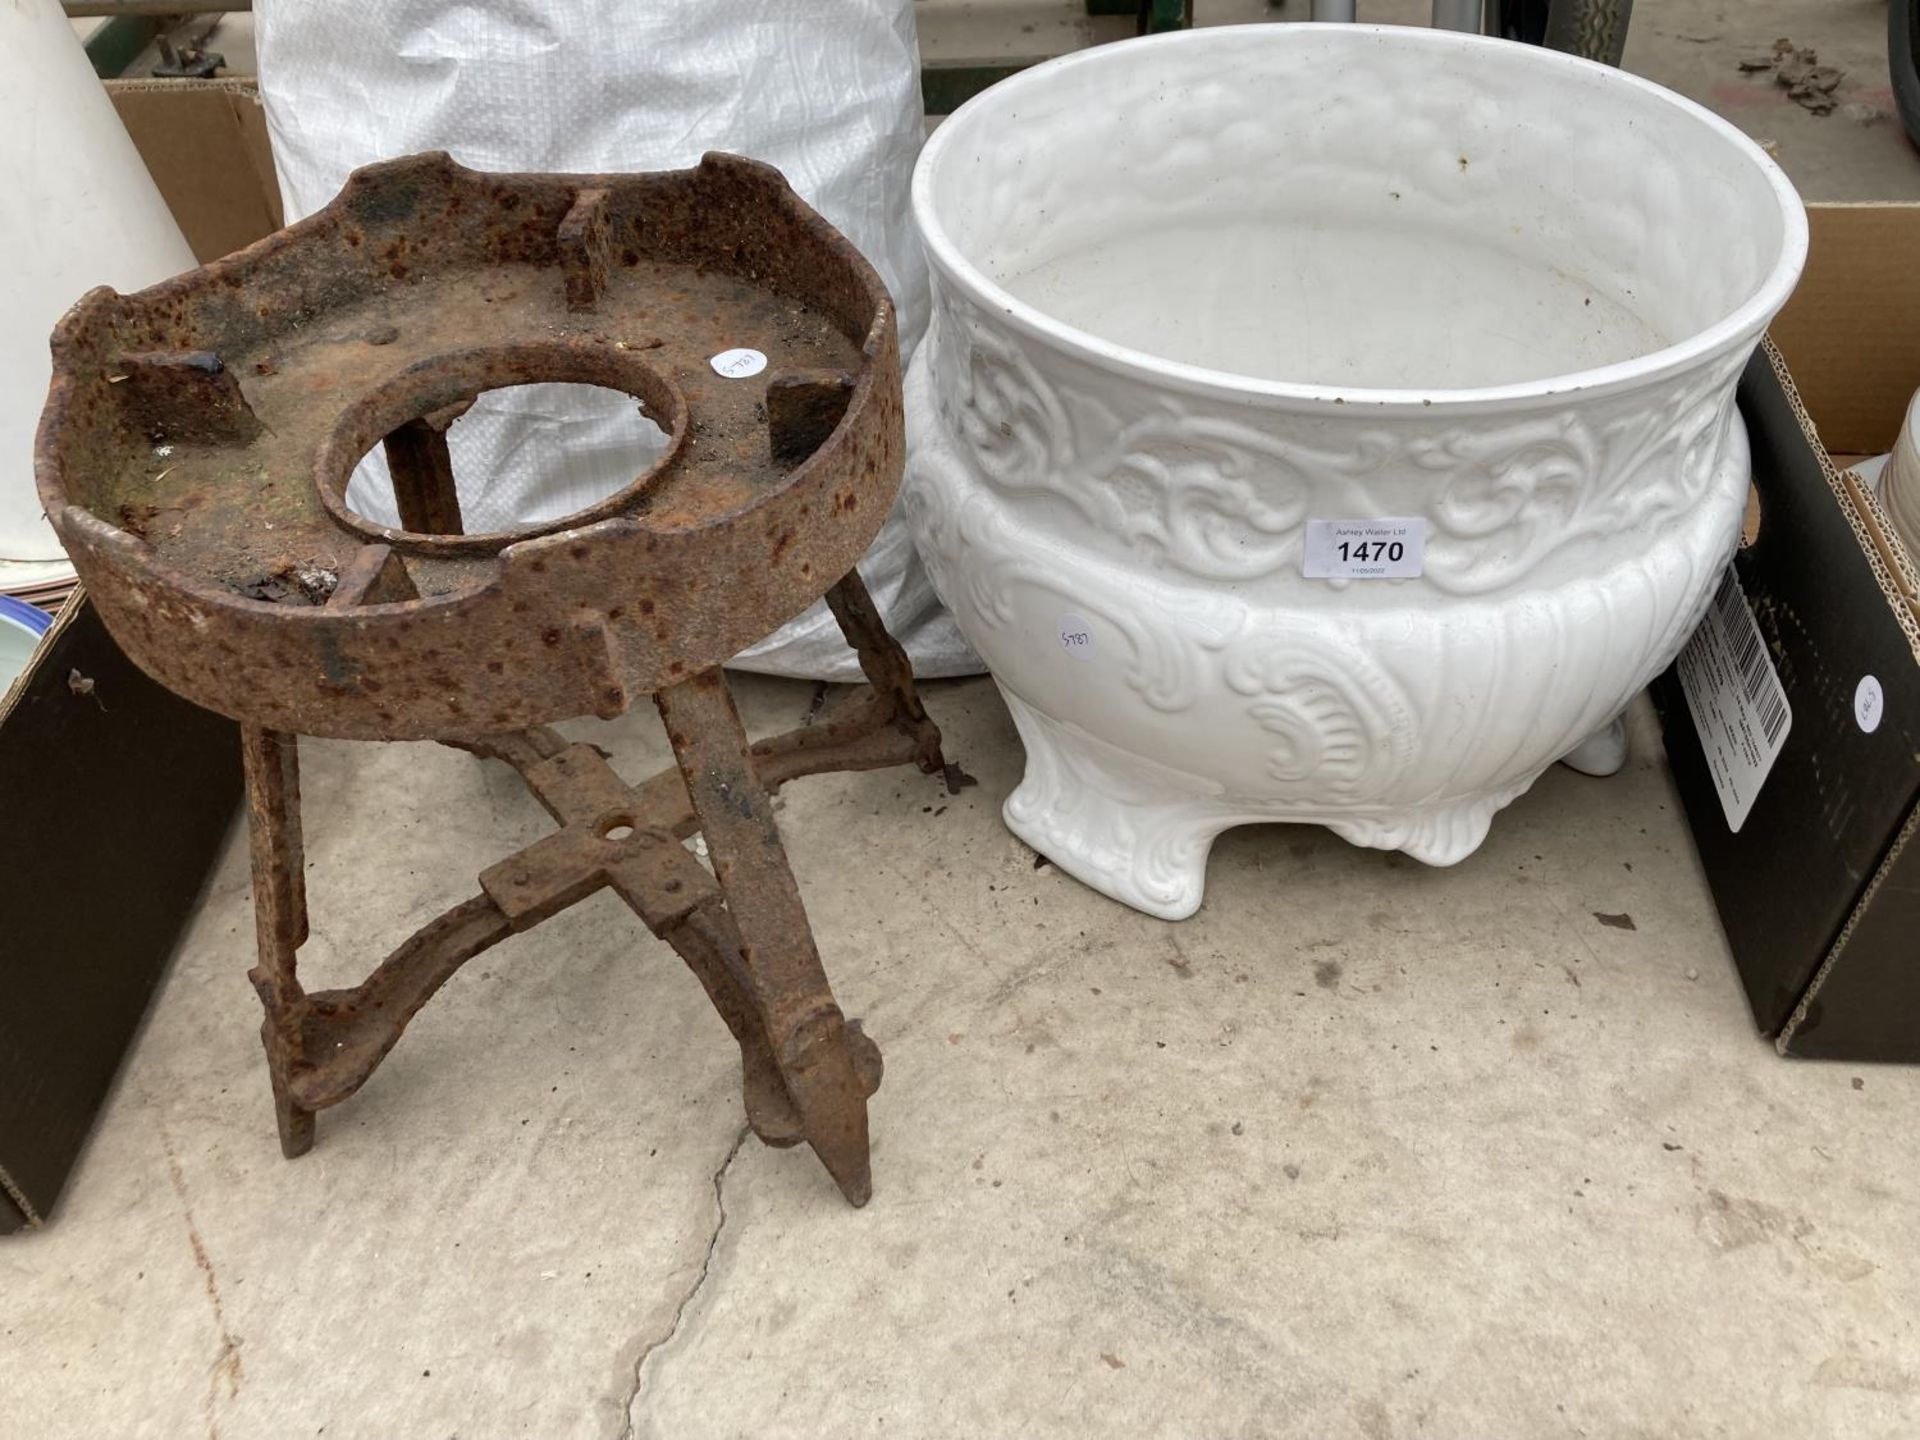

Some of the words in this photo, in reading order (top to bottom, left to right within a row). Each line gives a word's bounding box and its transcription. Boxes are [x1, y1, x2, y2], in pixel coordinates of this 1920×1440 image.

[1336, 528, 1362, 537] Ashley
[1393, 528, 1406, 536] Ltd
[1338, 541, 1404, 562] 1470
